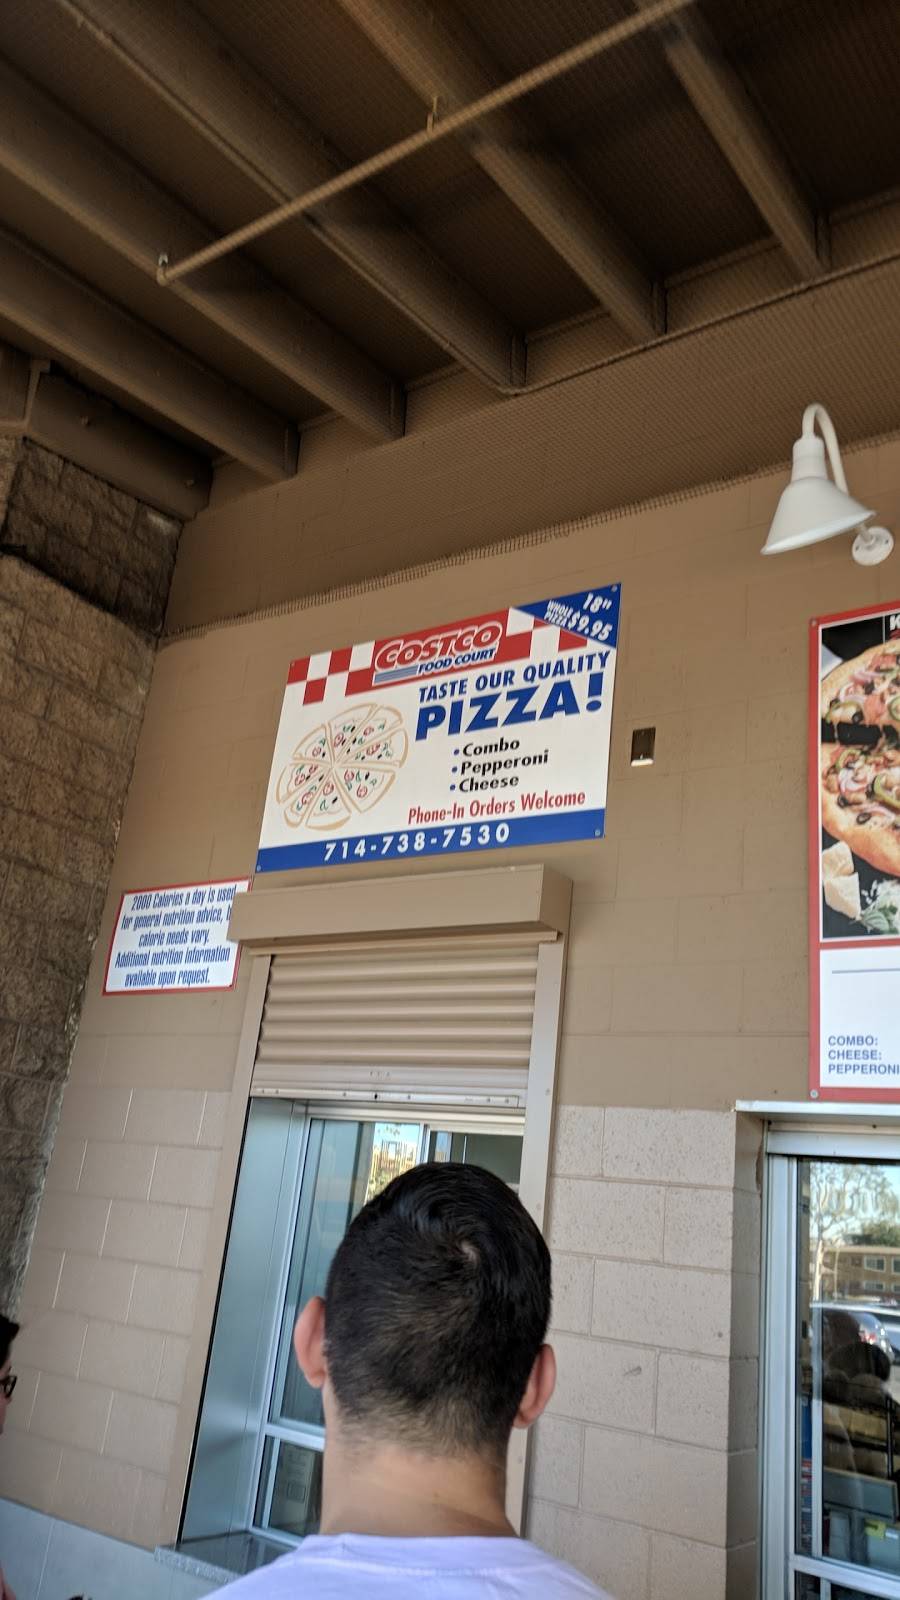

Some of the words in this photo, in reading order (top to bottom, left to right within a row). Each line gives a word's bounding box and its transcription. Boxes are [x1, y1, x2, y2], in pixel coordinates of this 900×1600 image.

[547, 600, 573, 619] WHOLE
[583, 592, 612, 613] 18"
[544, 609, 568, 627] PIZZA
[567, 610, 613, 641] $9.95
[375, 622, 501, 671] COSTCO
[418, 657, 453, 673] FOOD
[454, 648, 496, 665] COURT
[419, 679, 468, 703] TASTE
[475, 669, 515, 691] OUR
[523, 650, 610, 683] QUALITY
[415, 671, 604, 741] PIZZA!
[463, 737, 520, 757] Combo
[460, 749, 549, 776] Pepperoni
[459, 776, 519, 793] Cheese
[408, 802, 465, 825] Phone-In
[469, 797, 515, 818] Orders
[520, 790, 586, 812] Welcome
[324, 823, 510, 862] 714-738-7530
[131, 894, 152, 911] 2000
[152, 891, 183, 909] Calories
[185, 892, 191, 905] a
[191, 888, 206, 906] day
[207, 887, 216, 903] is
[121, 914, 133, 930] for
[133, 911, 162, 931] general
[162, 908, 195, 927] nutrition
[196, 905, 223, 923] advice,
[138, 929, 165, 947] calorie
[166, 928, 189, 944] needs
[191, 928, 209, 946] vary.
[115, 950, 150, 968] Additional
[150, 948, 184, 966] nutrition
[184, 945, 231, 964] information
[124, 969, 157, 987] available
[157, 970, 177, 988] upon
[177, 966, 210, 987] request.
[828, 1035, 878, 1046] COMBO:
[828, 1049, 882, 1060] CHEESE:
